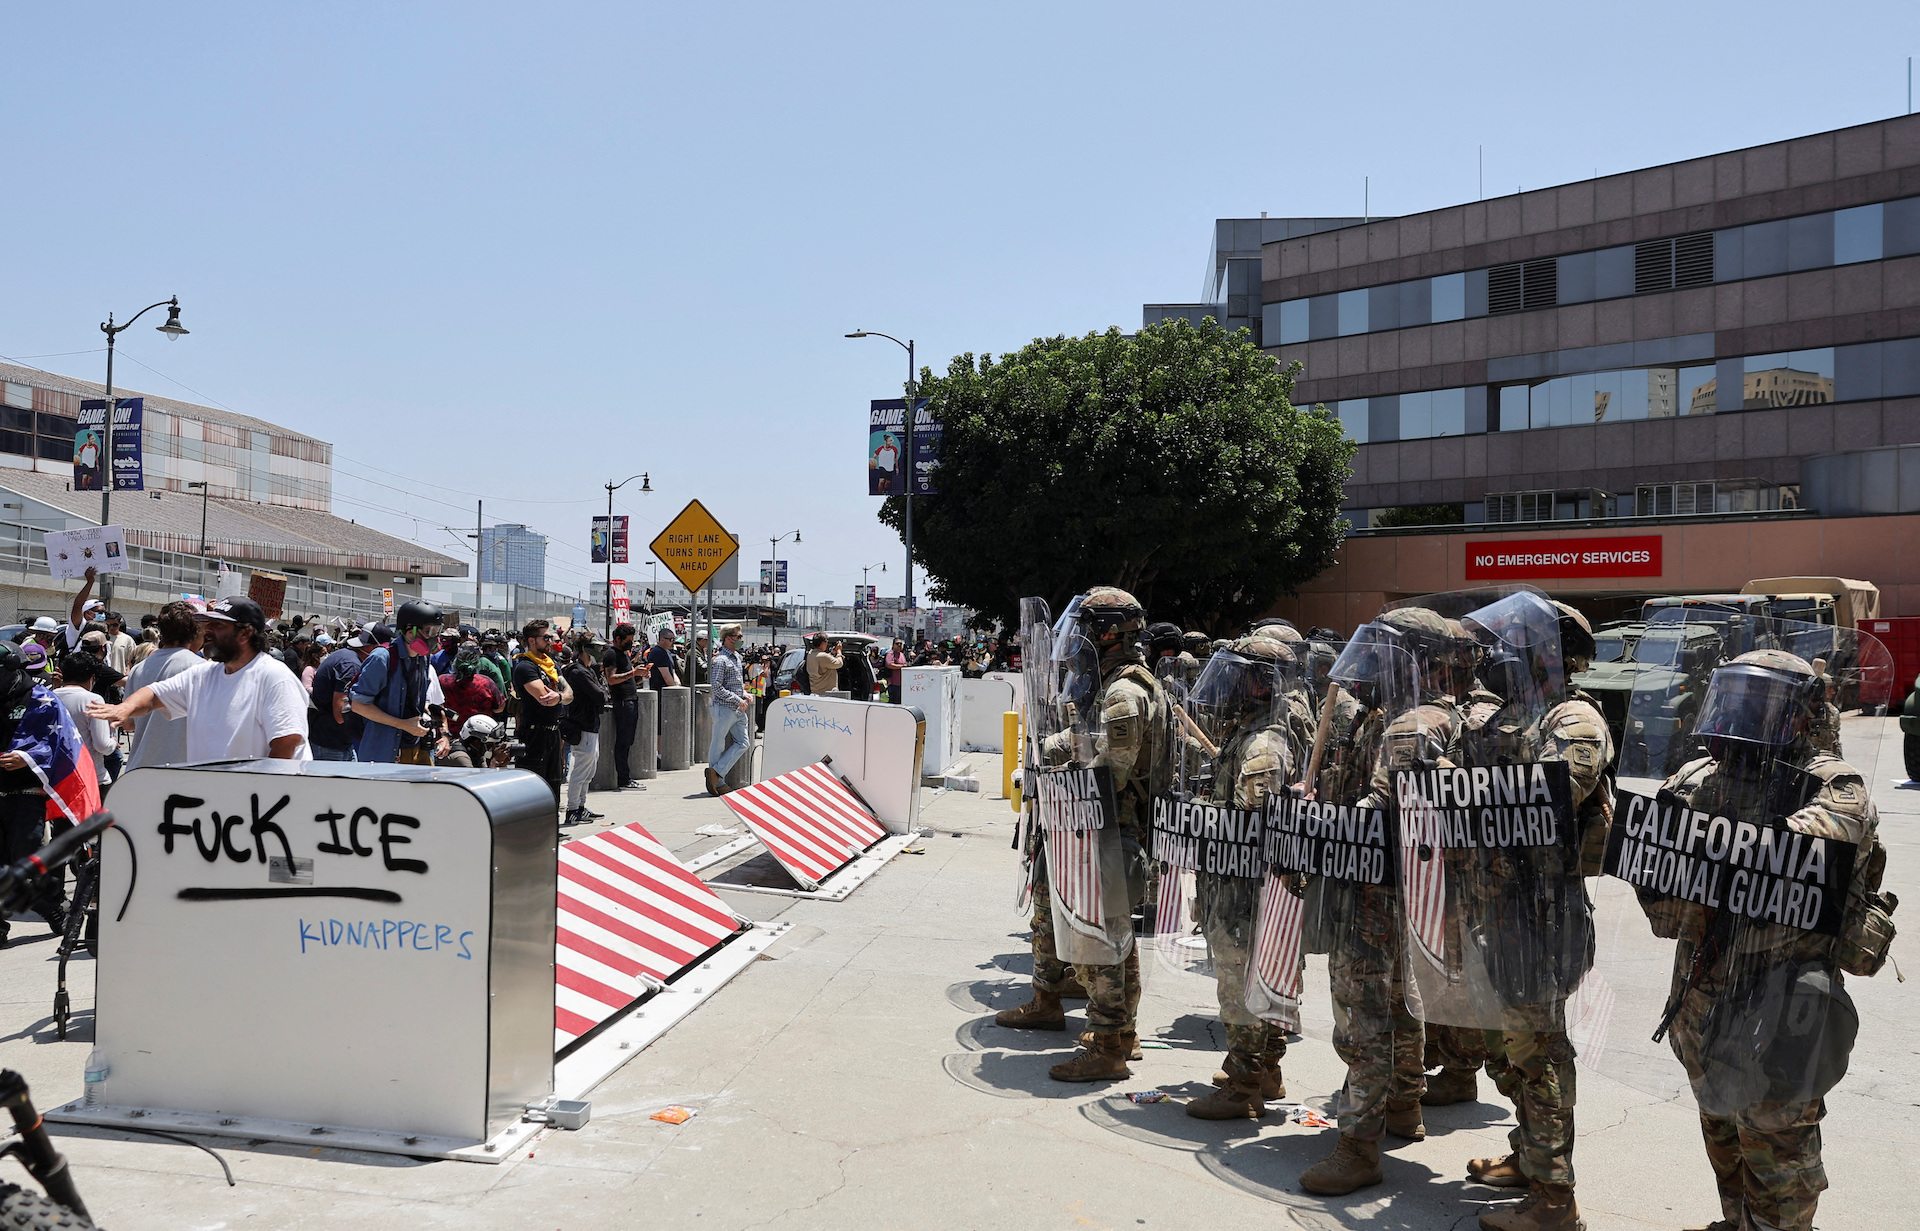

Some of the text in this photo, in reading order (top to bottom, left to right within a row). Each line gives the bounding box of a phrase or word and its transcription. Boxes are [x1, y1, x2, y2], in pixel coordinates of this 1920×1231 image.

[77, 407, 132, 424] GAME ON!
[870, 408, 934, 425] GAME ON
[665, 548, 723, 557] TURNS RIGHT
[669, 534, 719, 543] RIGHT LANE
[1475, 550, 1650, 567] NO EMERGENCY SERVICES
[256, 577, 282, 590] POSSE
[680, 562, 708, 571] AHEAD
[783, 703, 818, 716] FUCK
[1396, 763, 1553, 808] CALIFORNIA
[158, 793, 429, 876] FUCK ICE
[1153, 796, 1260, 843] CALIFORNIA
[1266, 793, 1385, 847] CALIFORNIA
[1400, 805, 1557, 848] NATIONAL GUARD
[1625, 795, 1826, 884] CALIFORNIA
[1151, 828, 1262, 878] NATIONAL GUARD
[1263, 828, 1385, 884] NATIONAL GUARD
[1616, 837, 1823, 931] NATIONAL GUARD
[299, 917, 474, 959] KIDNAPPERS
